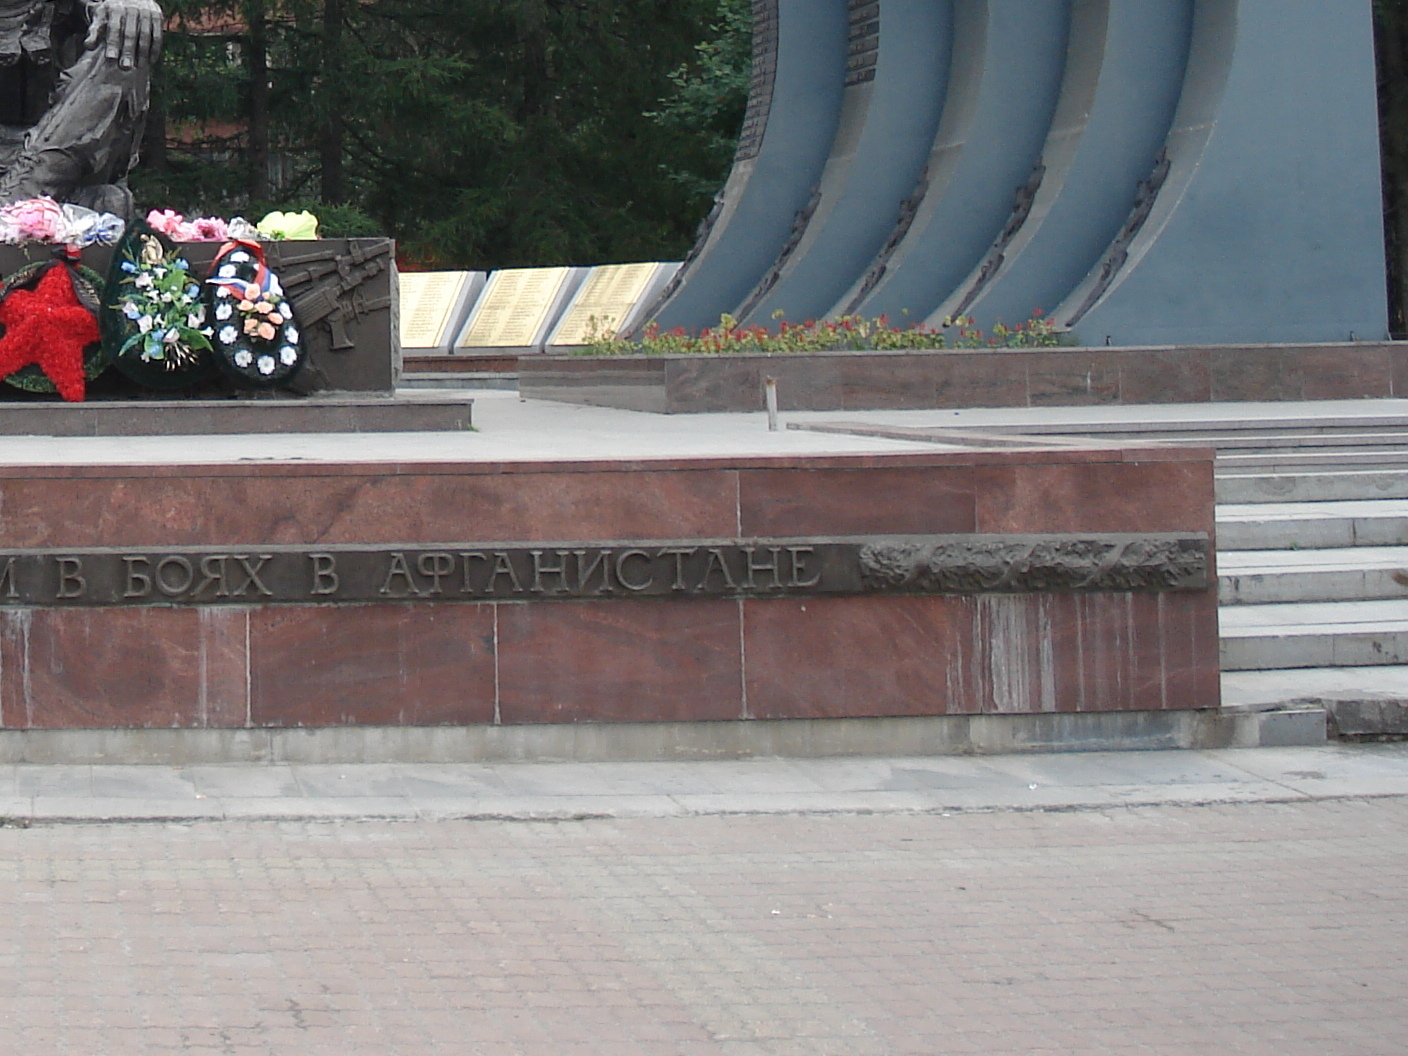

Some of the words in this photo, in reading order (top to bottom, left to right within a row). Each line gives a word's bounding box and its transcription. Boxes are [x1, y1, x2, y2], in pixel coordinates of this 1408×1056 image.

[55, 556, 87, 598] В
[122, 554, 273, 598] БОЯХ
[308, 553, 340, 595] В
[379, 546, 823, 593] АФГАНИСТАНЕ
